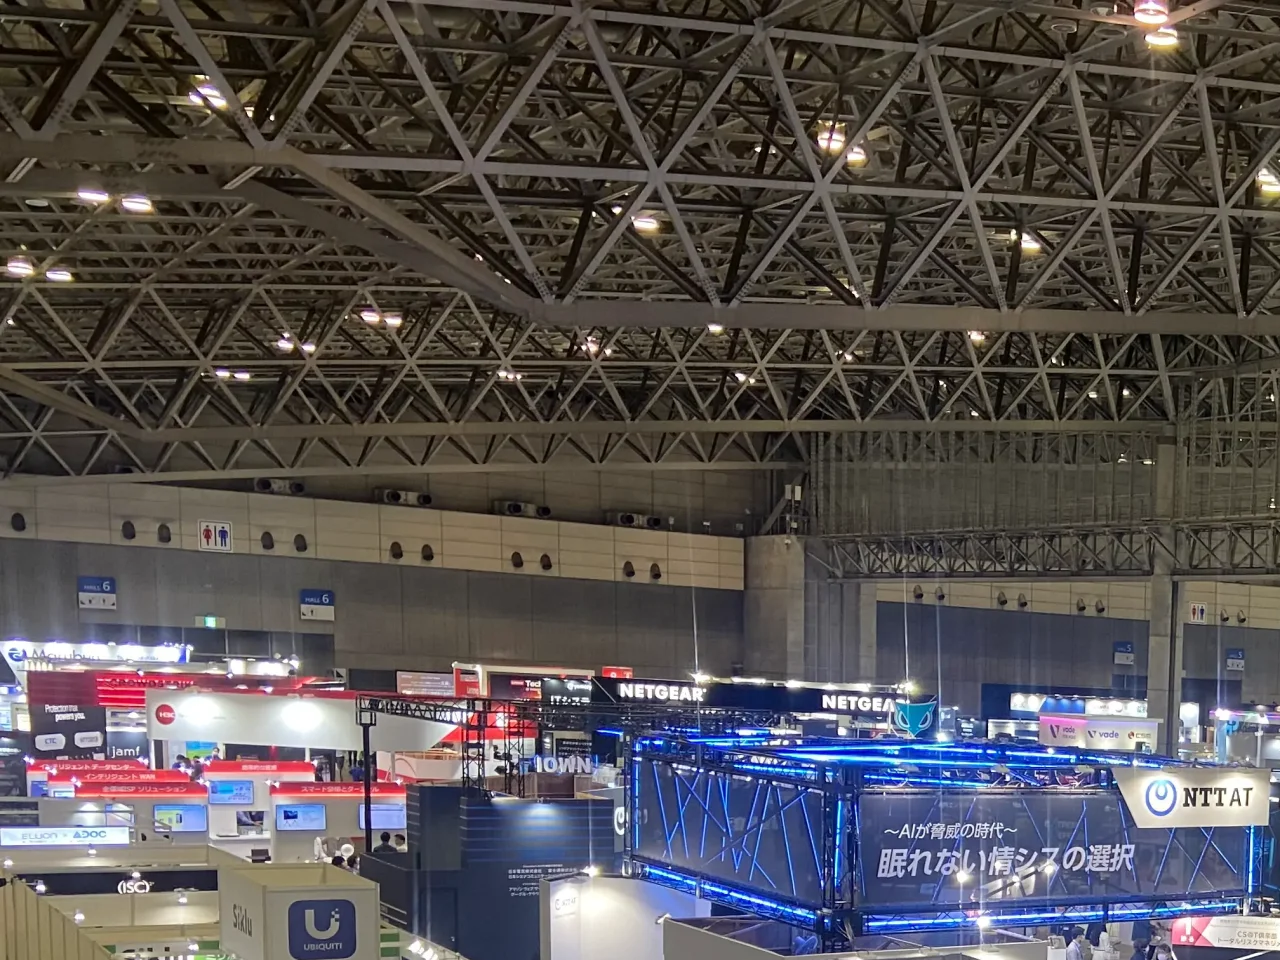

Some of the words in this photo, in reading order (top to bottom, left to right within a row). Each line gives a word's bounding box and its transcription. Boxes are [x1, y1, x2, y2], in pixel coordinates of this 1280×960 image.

[102, 581, 110, 591] 6
[322, 594, 329, 604] 6
[619, 684, 704, 702] NETGEAR
[822, 695, 905, 713] NETGEA
[1099, 731, 1119, 739] vade
[112, 746, 140, 759] jamf
[536, 757, 592, 773] IOWN
[1182, 788, 1227, 808] NTT
[1230, 786, 1254, 807] AT
[877, 843, 1135, 879] 眠れない情シスの選択
[232, 903, 254, 938] Siklu
[304, 942, 343, 951] UBIQUITI
